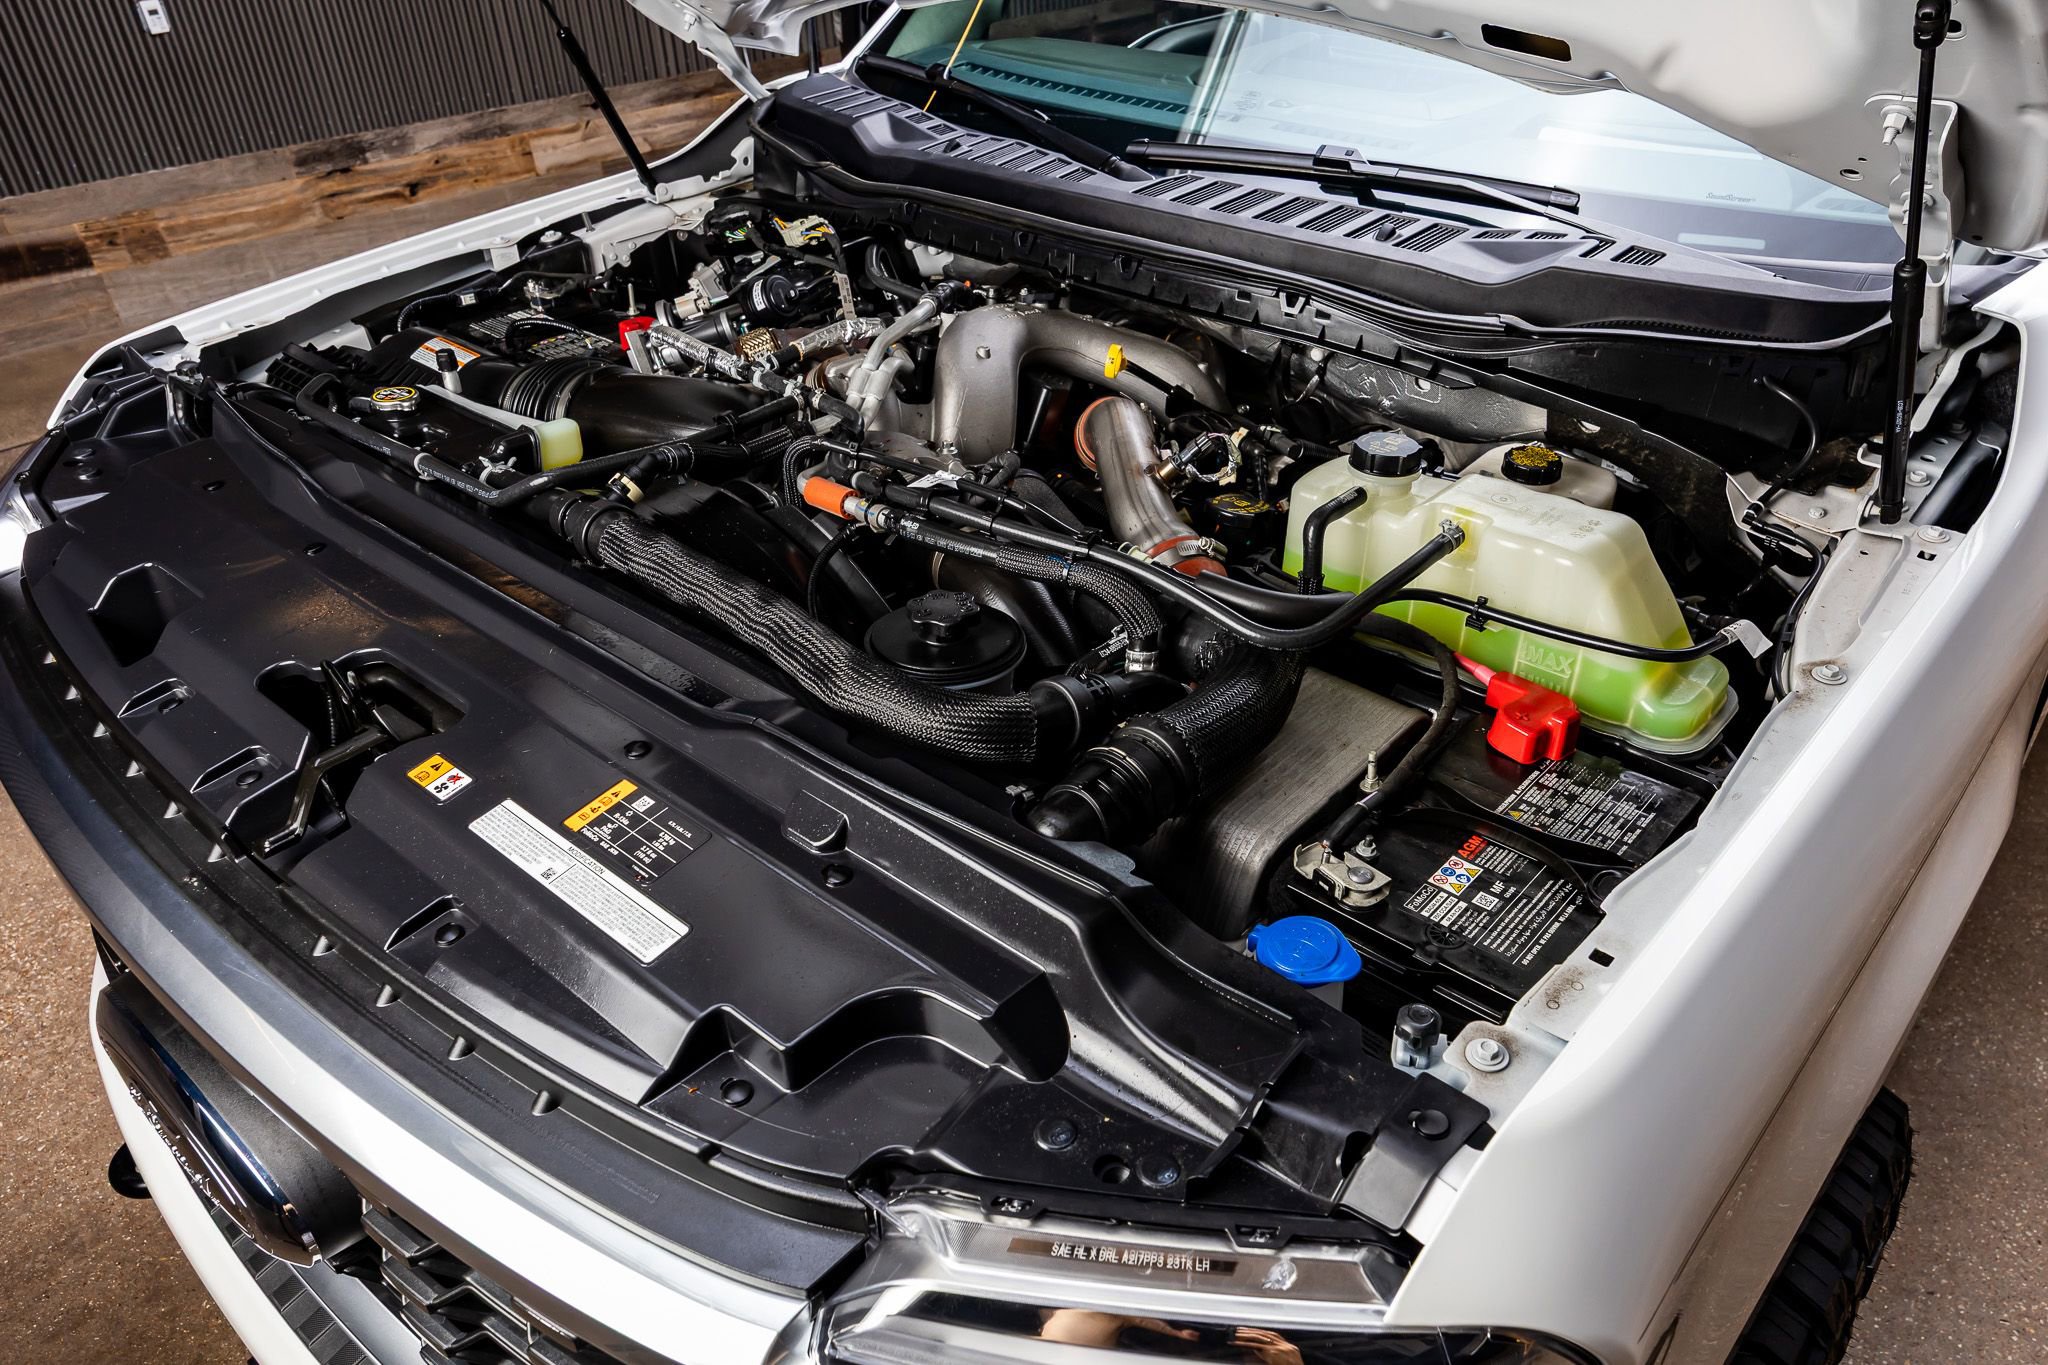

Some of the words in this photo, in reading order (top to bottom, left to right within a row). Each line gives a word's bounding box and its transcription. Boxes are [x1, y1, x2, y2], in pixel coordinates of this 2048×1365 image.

[1527, 645, 1575, 673] MAX
[1458, 835, 1483, 858] AGM
[567, 846, 605, 875] MODIFICATION
[1407, 885, 1434, 910] FoMoCo
[1489, 880, 1505, 894] MF
[1051, 1242, 1071, 1258] SAE
[1073, 1245, 1087, 1260] HL
[1089, 1246, 1097, 1261] X
[1098, 1248, 1119, 1263] DRL
[1196, 1257, 1210, 1272] LH
